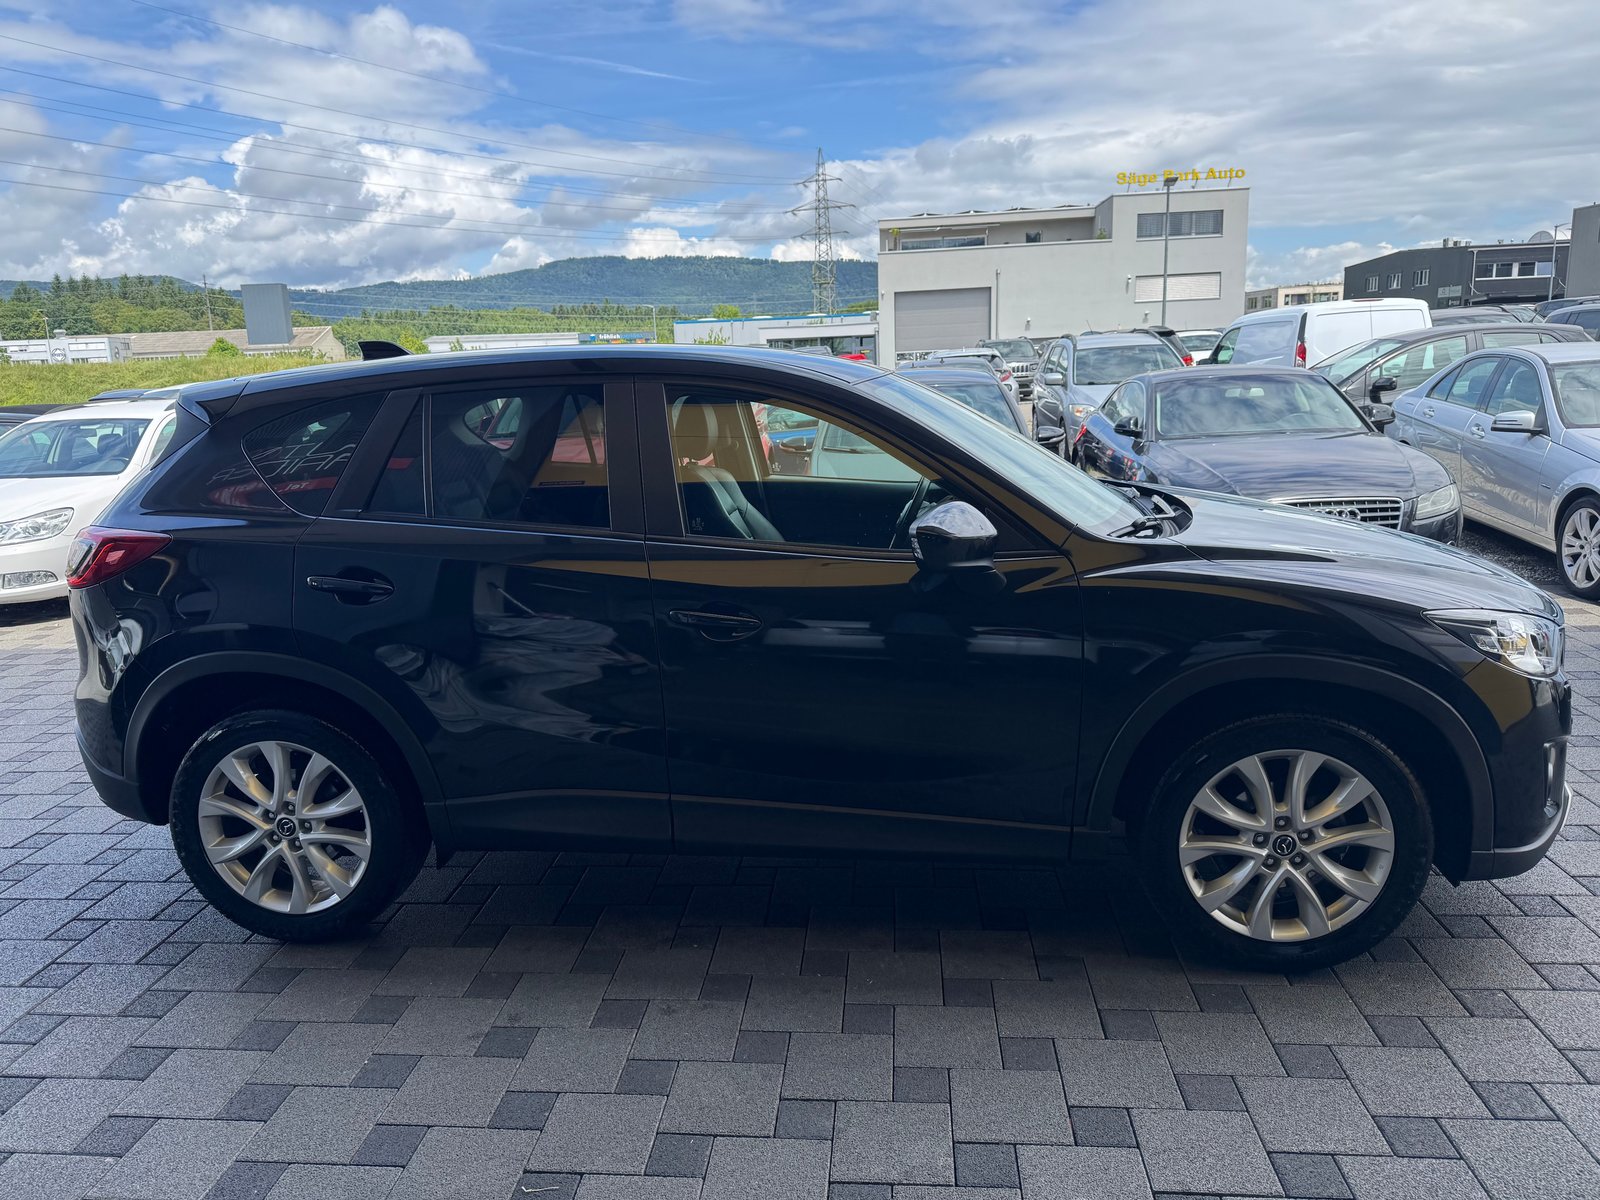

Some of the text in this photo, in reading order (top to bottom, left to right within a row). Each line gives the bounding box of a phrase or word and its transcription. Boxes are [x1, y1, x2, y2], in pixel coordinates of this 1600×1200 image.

[1116, 167, 1246, 186] Säge Park Auto
